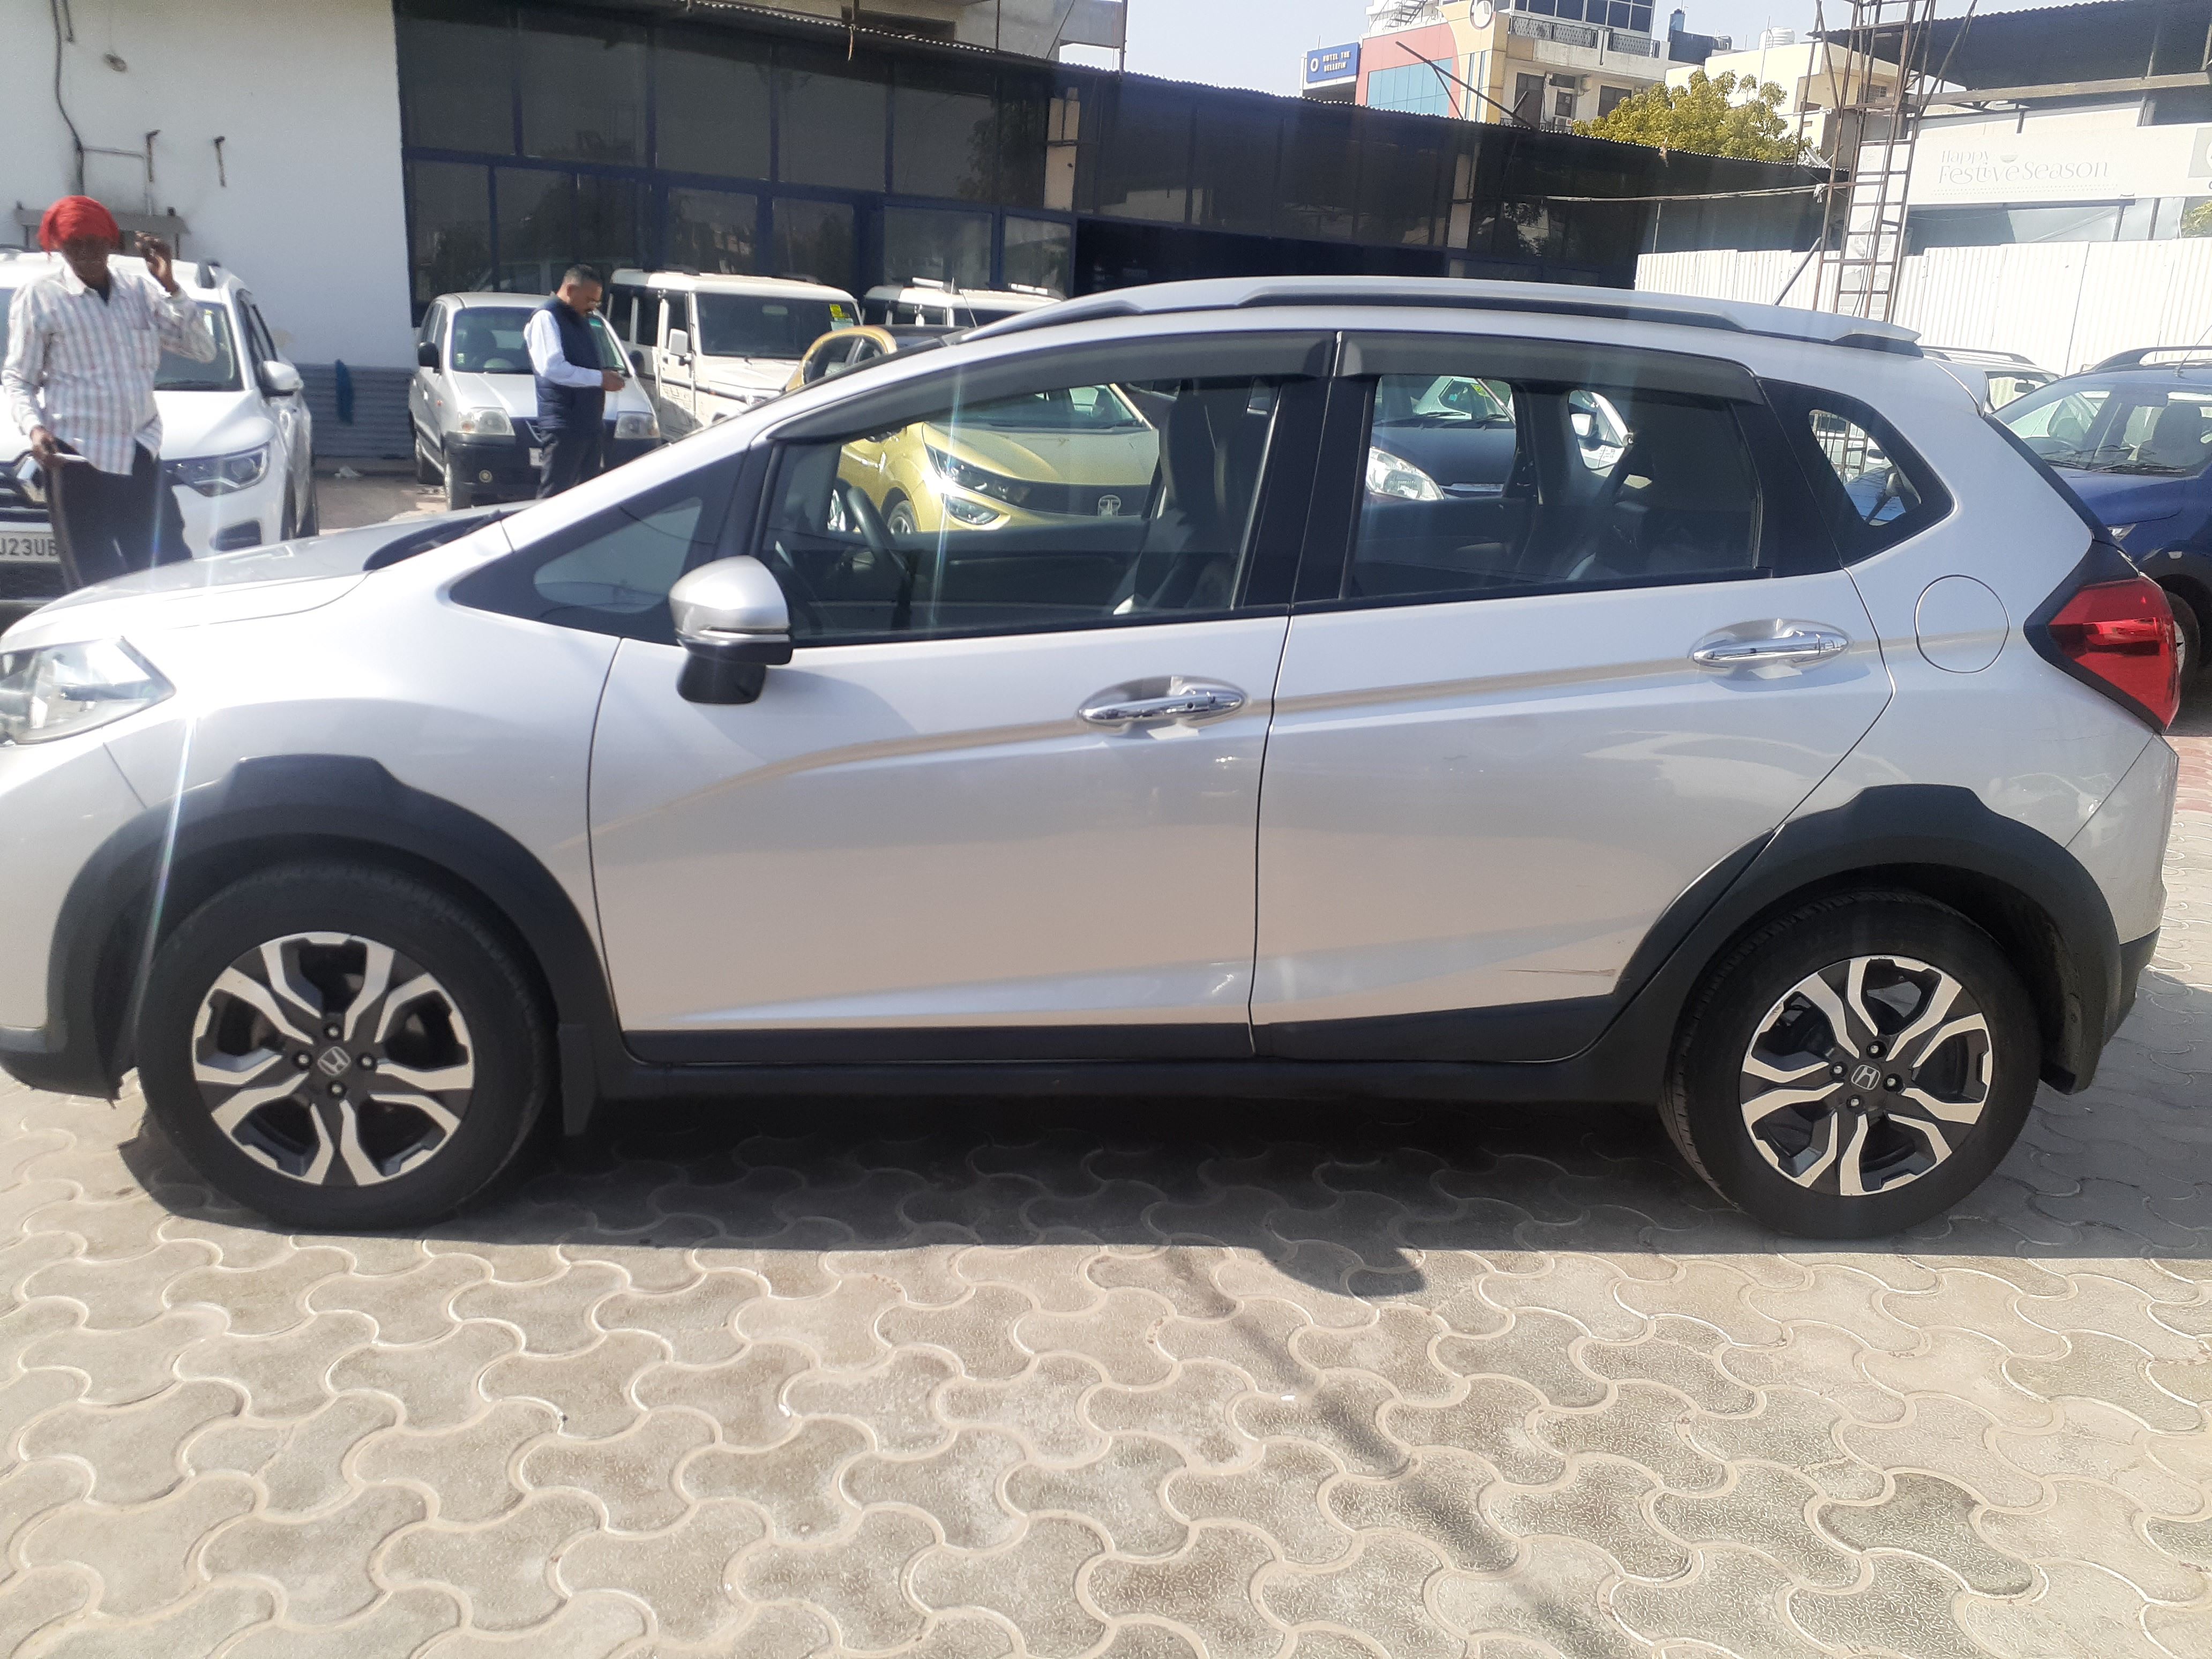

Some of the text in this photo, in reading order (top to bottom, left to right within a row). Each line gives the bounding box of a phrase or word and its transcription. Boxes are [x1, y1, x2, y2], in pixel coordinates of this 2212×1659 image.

[1323, 53, 1338, 62] HOTEL
[1941, 150, 1988, 164] Happy
[1939, 162, 2019, 184] Festive
